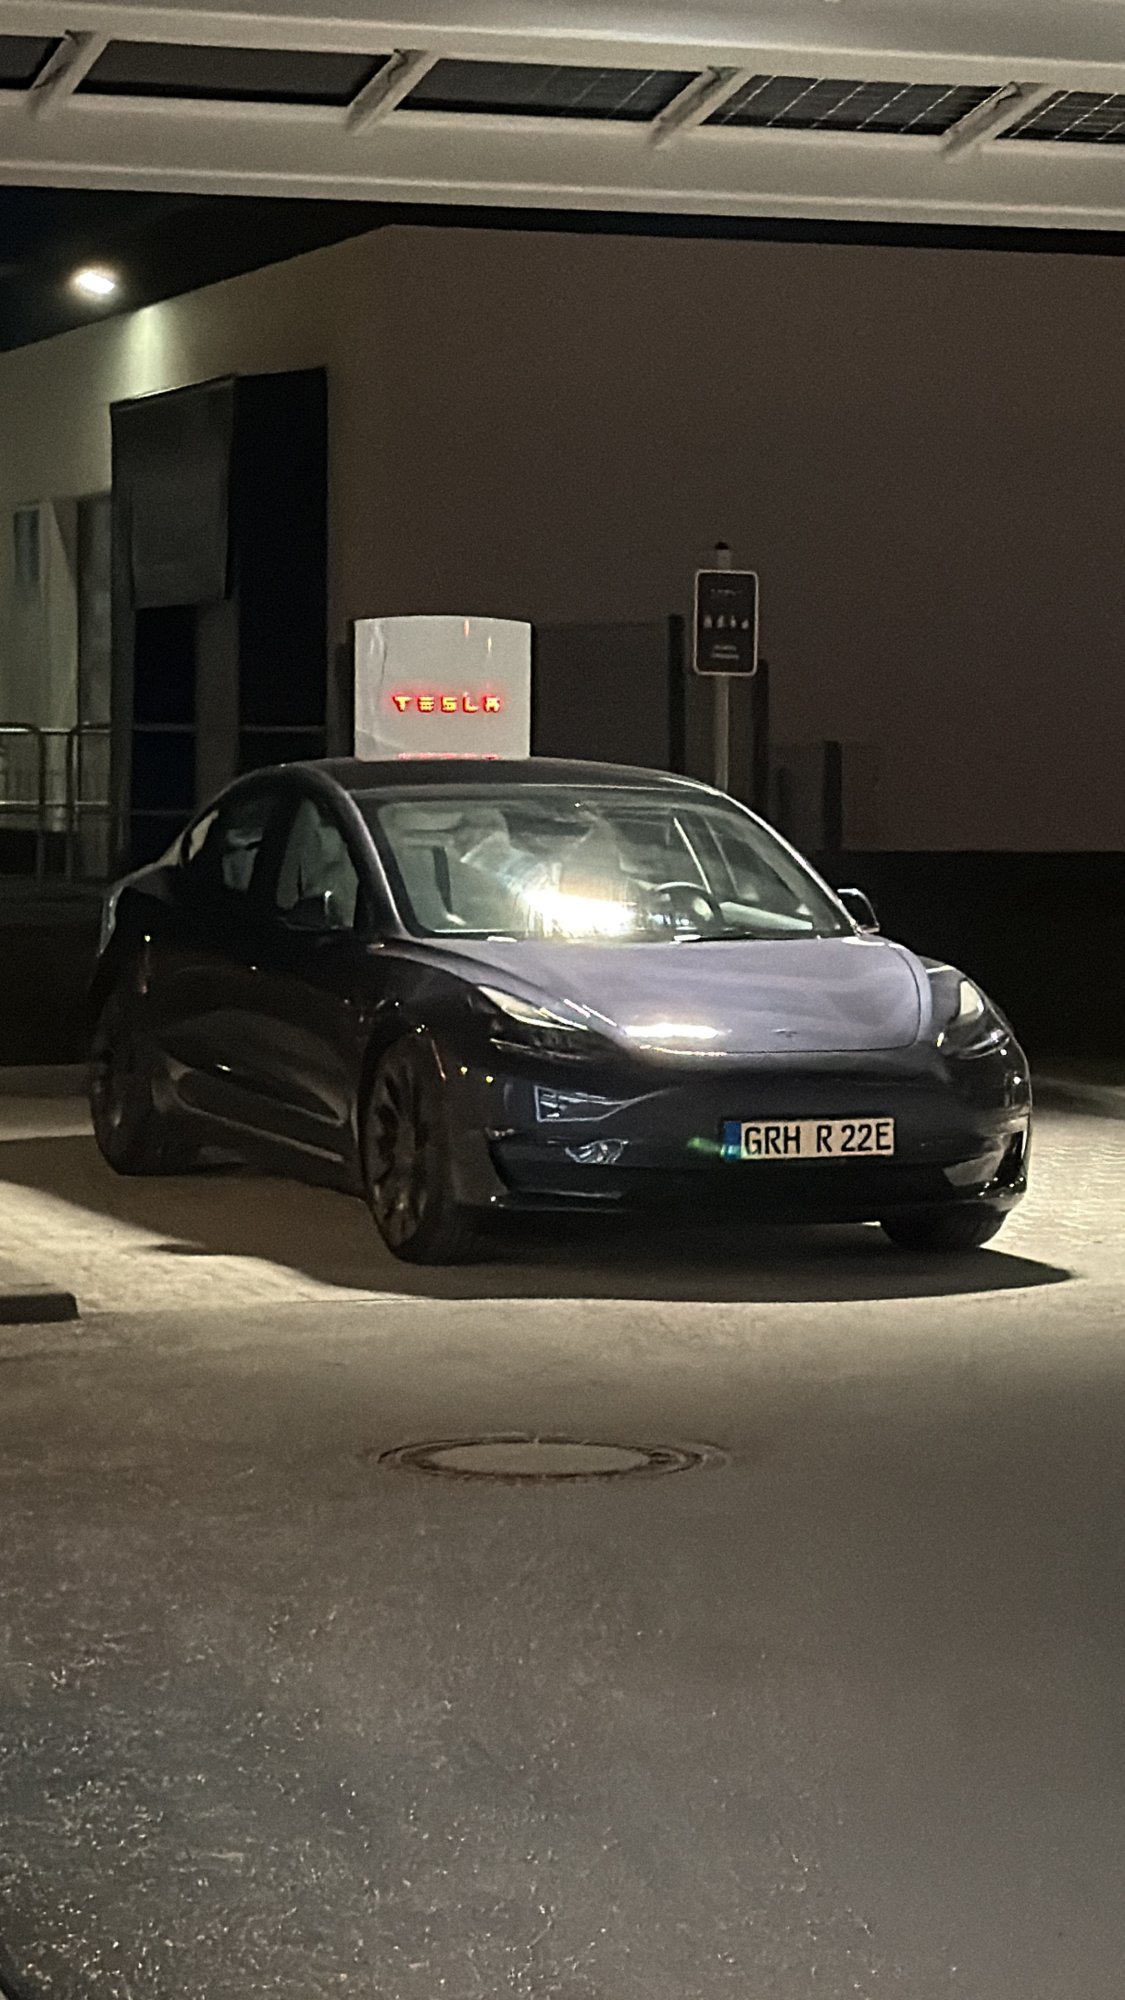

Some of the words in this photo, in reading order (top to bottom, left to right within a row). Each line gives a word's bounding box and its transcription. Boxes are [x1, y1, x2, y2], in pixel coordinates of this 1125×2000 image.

[393, 695, 501, 713] TESLA
[744, 1125, 801, 1155] GRH
[816, 1124, 832, 1153] R
[841, 1122, 892, 1152] 22E
